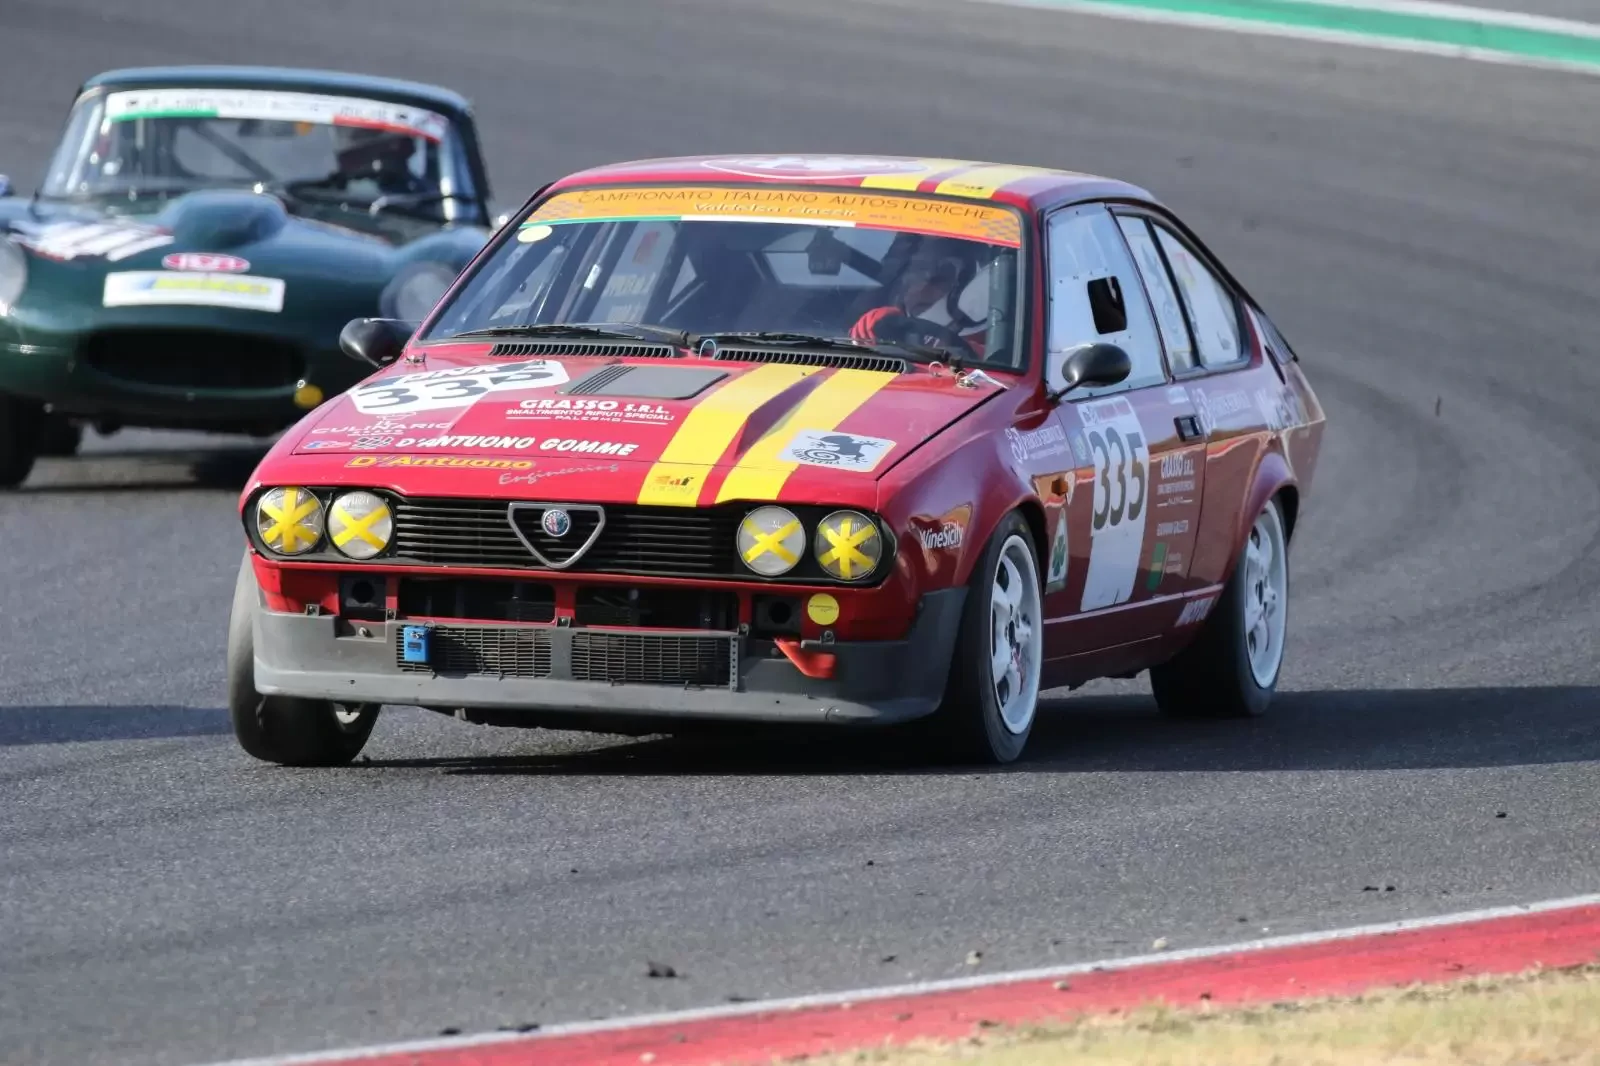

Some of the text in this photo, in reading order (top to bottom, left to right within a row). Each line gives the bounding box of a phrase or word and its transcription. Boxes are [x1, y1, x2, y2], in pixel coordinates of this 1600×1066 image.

[578, 190, 994, 220] CAMPIONATO ITALIANO AUTOSTORICHE
[505, 408, 676, 421] SMALTIMENTO RIFIUTI SPECIALI
[519, 400, 670, 414] GRASSO S.R.L.
[395, 435, 535, 449] D'ANTUONO
[540, 438, 639, 456] GOMME
[498, 464, 620, 485] Engineering
[1089, 427, 1145, 530] 335
